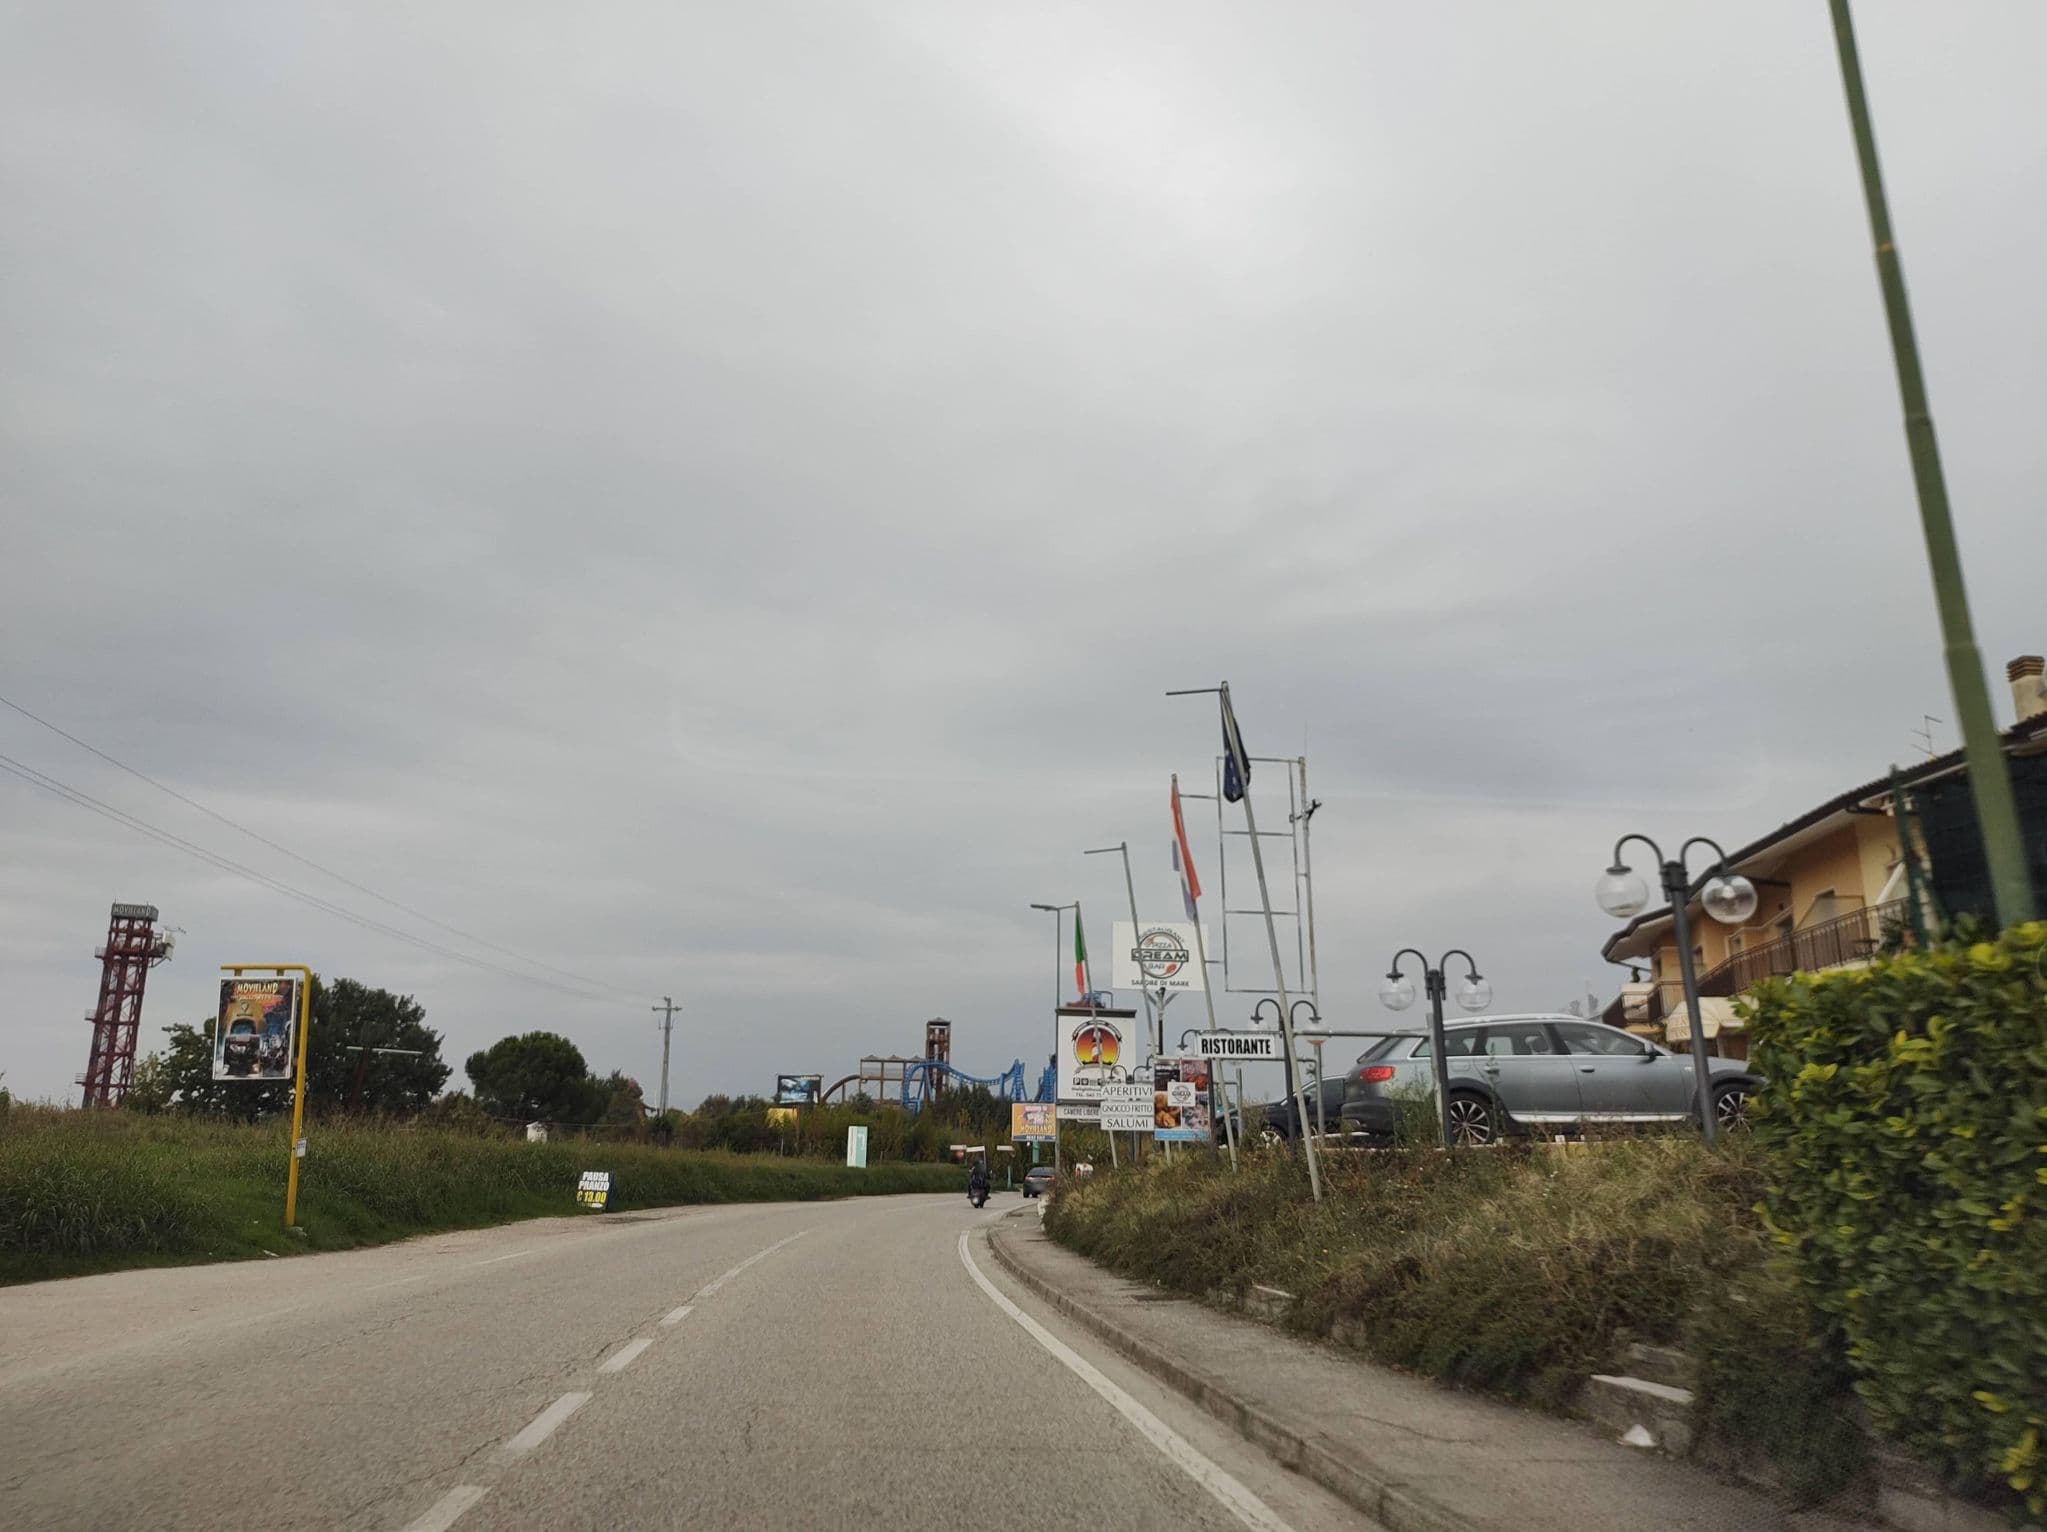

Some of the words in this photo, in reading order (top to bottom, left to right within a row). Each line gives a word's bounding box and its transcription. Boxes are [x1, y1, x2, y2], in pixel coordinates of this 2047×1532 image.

[237, 982, 279, 994] MOVIELAND
[1201, 1038, 1272, 1055] RISTORANTE
[1102, 1086, 1153, 1097] APERITIVI
[1102, 1104, 1131, 1113] GNOCCO
[1131, 1104, 1153, 1113] FRITTO
[1106, 1118, 1149, 1129] SALUMI
[582, 1171, 609, 1181] PAUSA
[577, 1180, 610, 1191] PRANZO
[584, 1191, 607, 1204] 13.00
